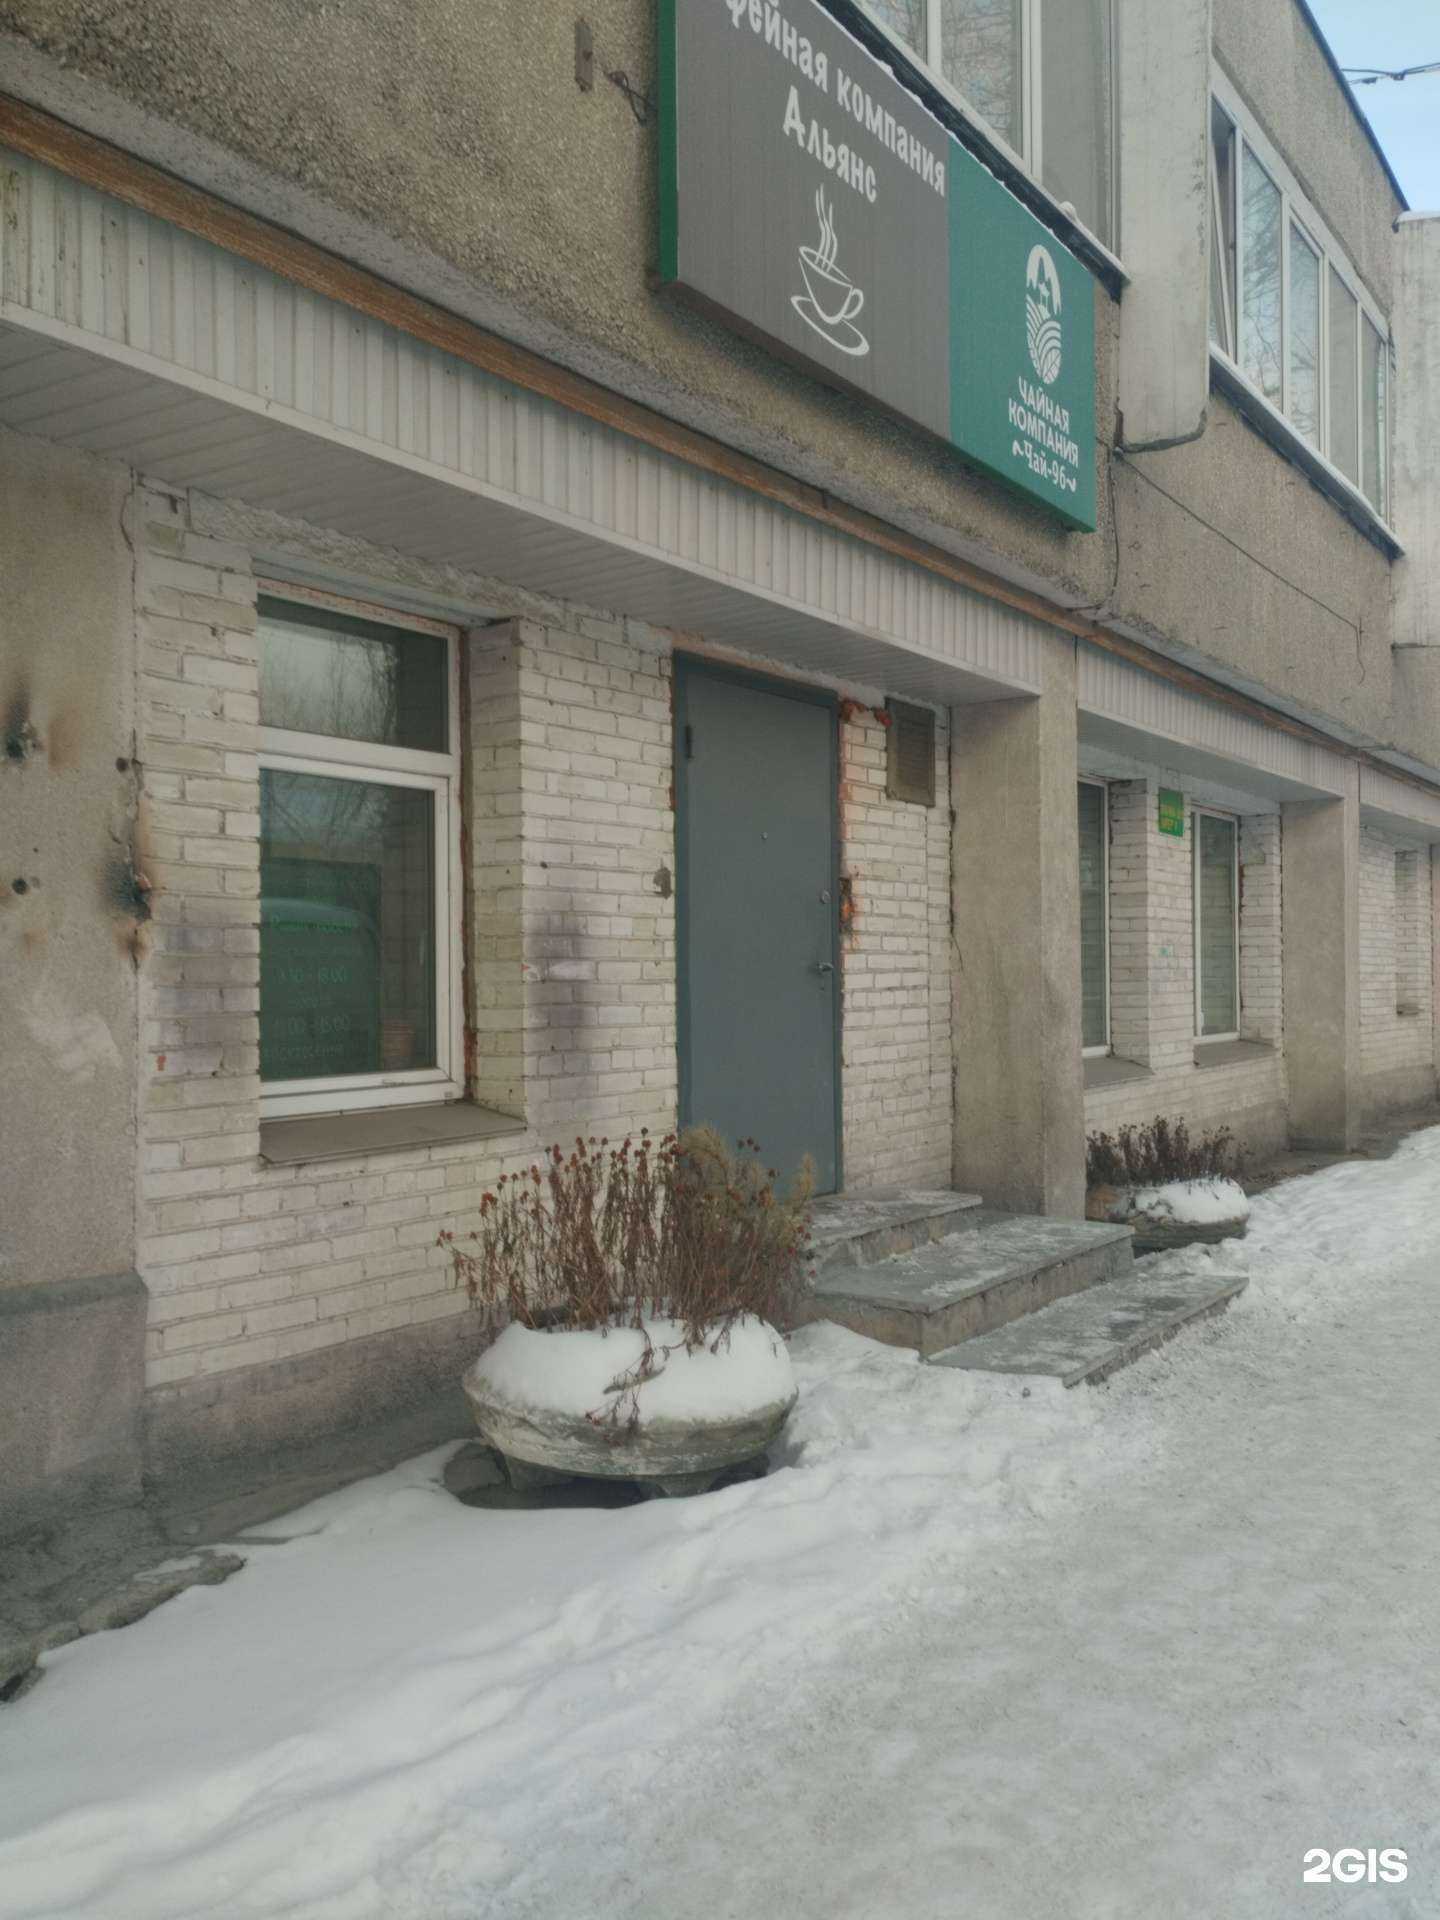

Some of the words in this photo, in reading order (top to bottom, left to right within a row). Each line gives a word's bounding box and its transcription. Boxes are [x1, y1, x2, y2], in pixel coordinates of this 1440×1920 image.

[783, 85, 877, 203] Альянс
[837, 67, 945, 196] компания
[1008, 397, 1079, 468] КОМПАНИЯ
[1018, 375, 1069, 434] ЧАЙНАЯ
[1023, 439, 1066, 490] Чай-96
